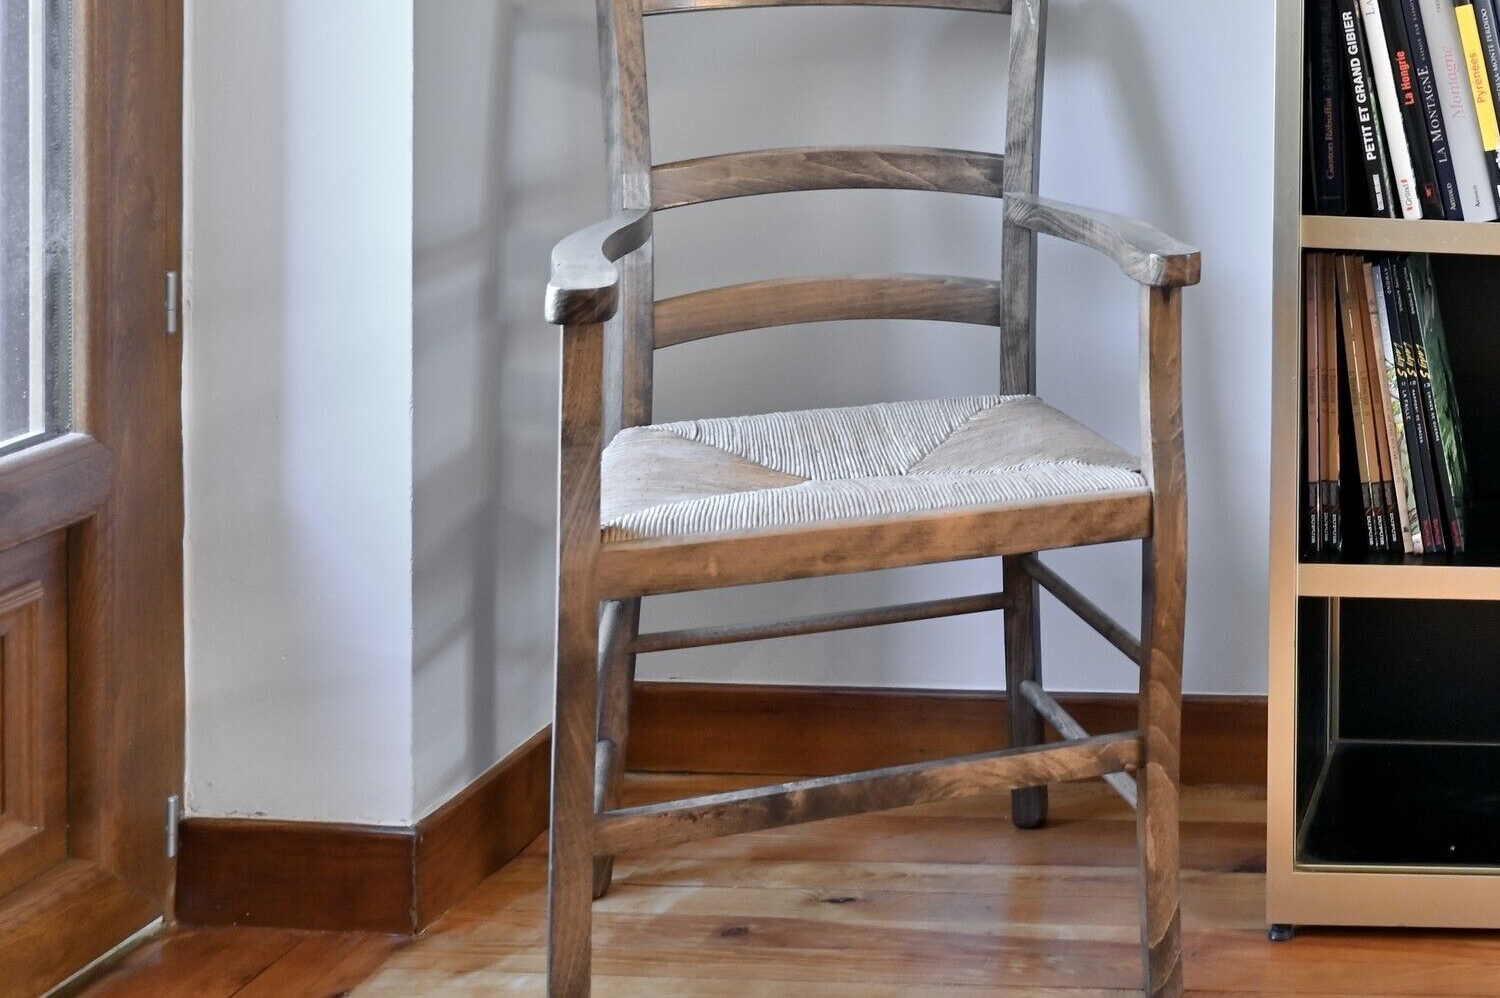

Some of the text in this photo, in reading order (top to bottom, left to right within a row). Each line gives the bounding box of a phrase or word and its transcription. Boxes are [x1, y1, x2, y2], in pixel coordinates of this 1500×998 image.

[1342, 11, 1358, 55] GIBIER
[1479, 8, 1492, 42] PERDIDO
[1350, 57, 1367, 103] GRAND
[1396, 51, 1415, 106] La Hongrie
[1470, 53, 1486, 103] Pyrénées
[1358, 106, 1370, 122] ET
[1417, 66, 1447, 163] LA MONTAGNE
[1361, 125, 1376, 161] PETIT
[1401, 389, 1408, 399] LA
[1403, 398, 1411, 420] FAILLE
